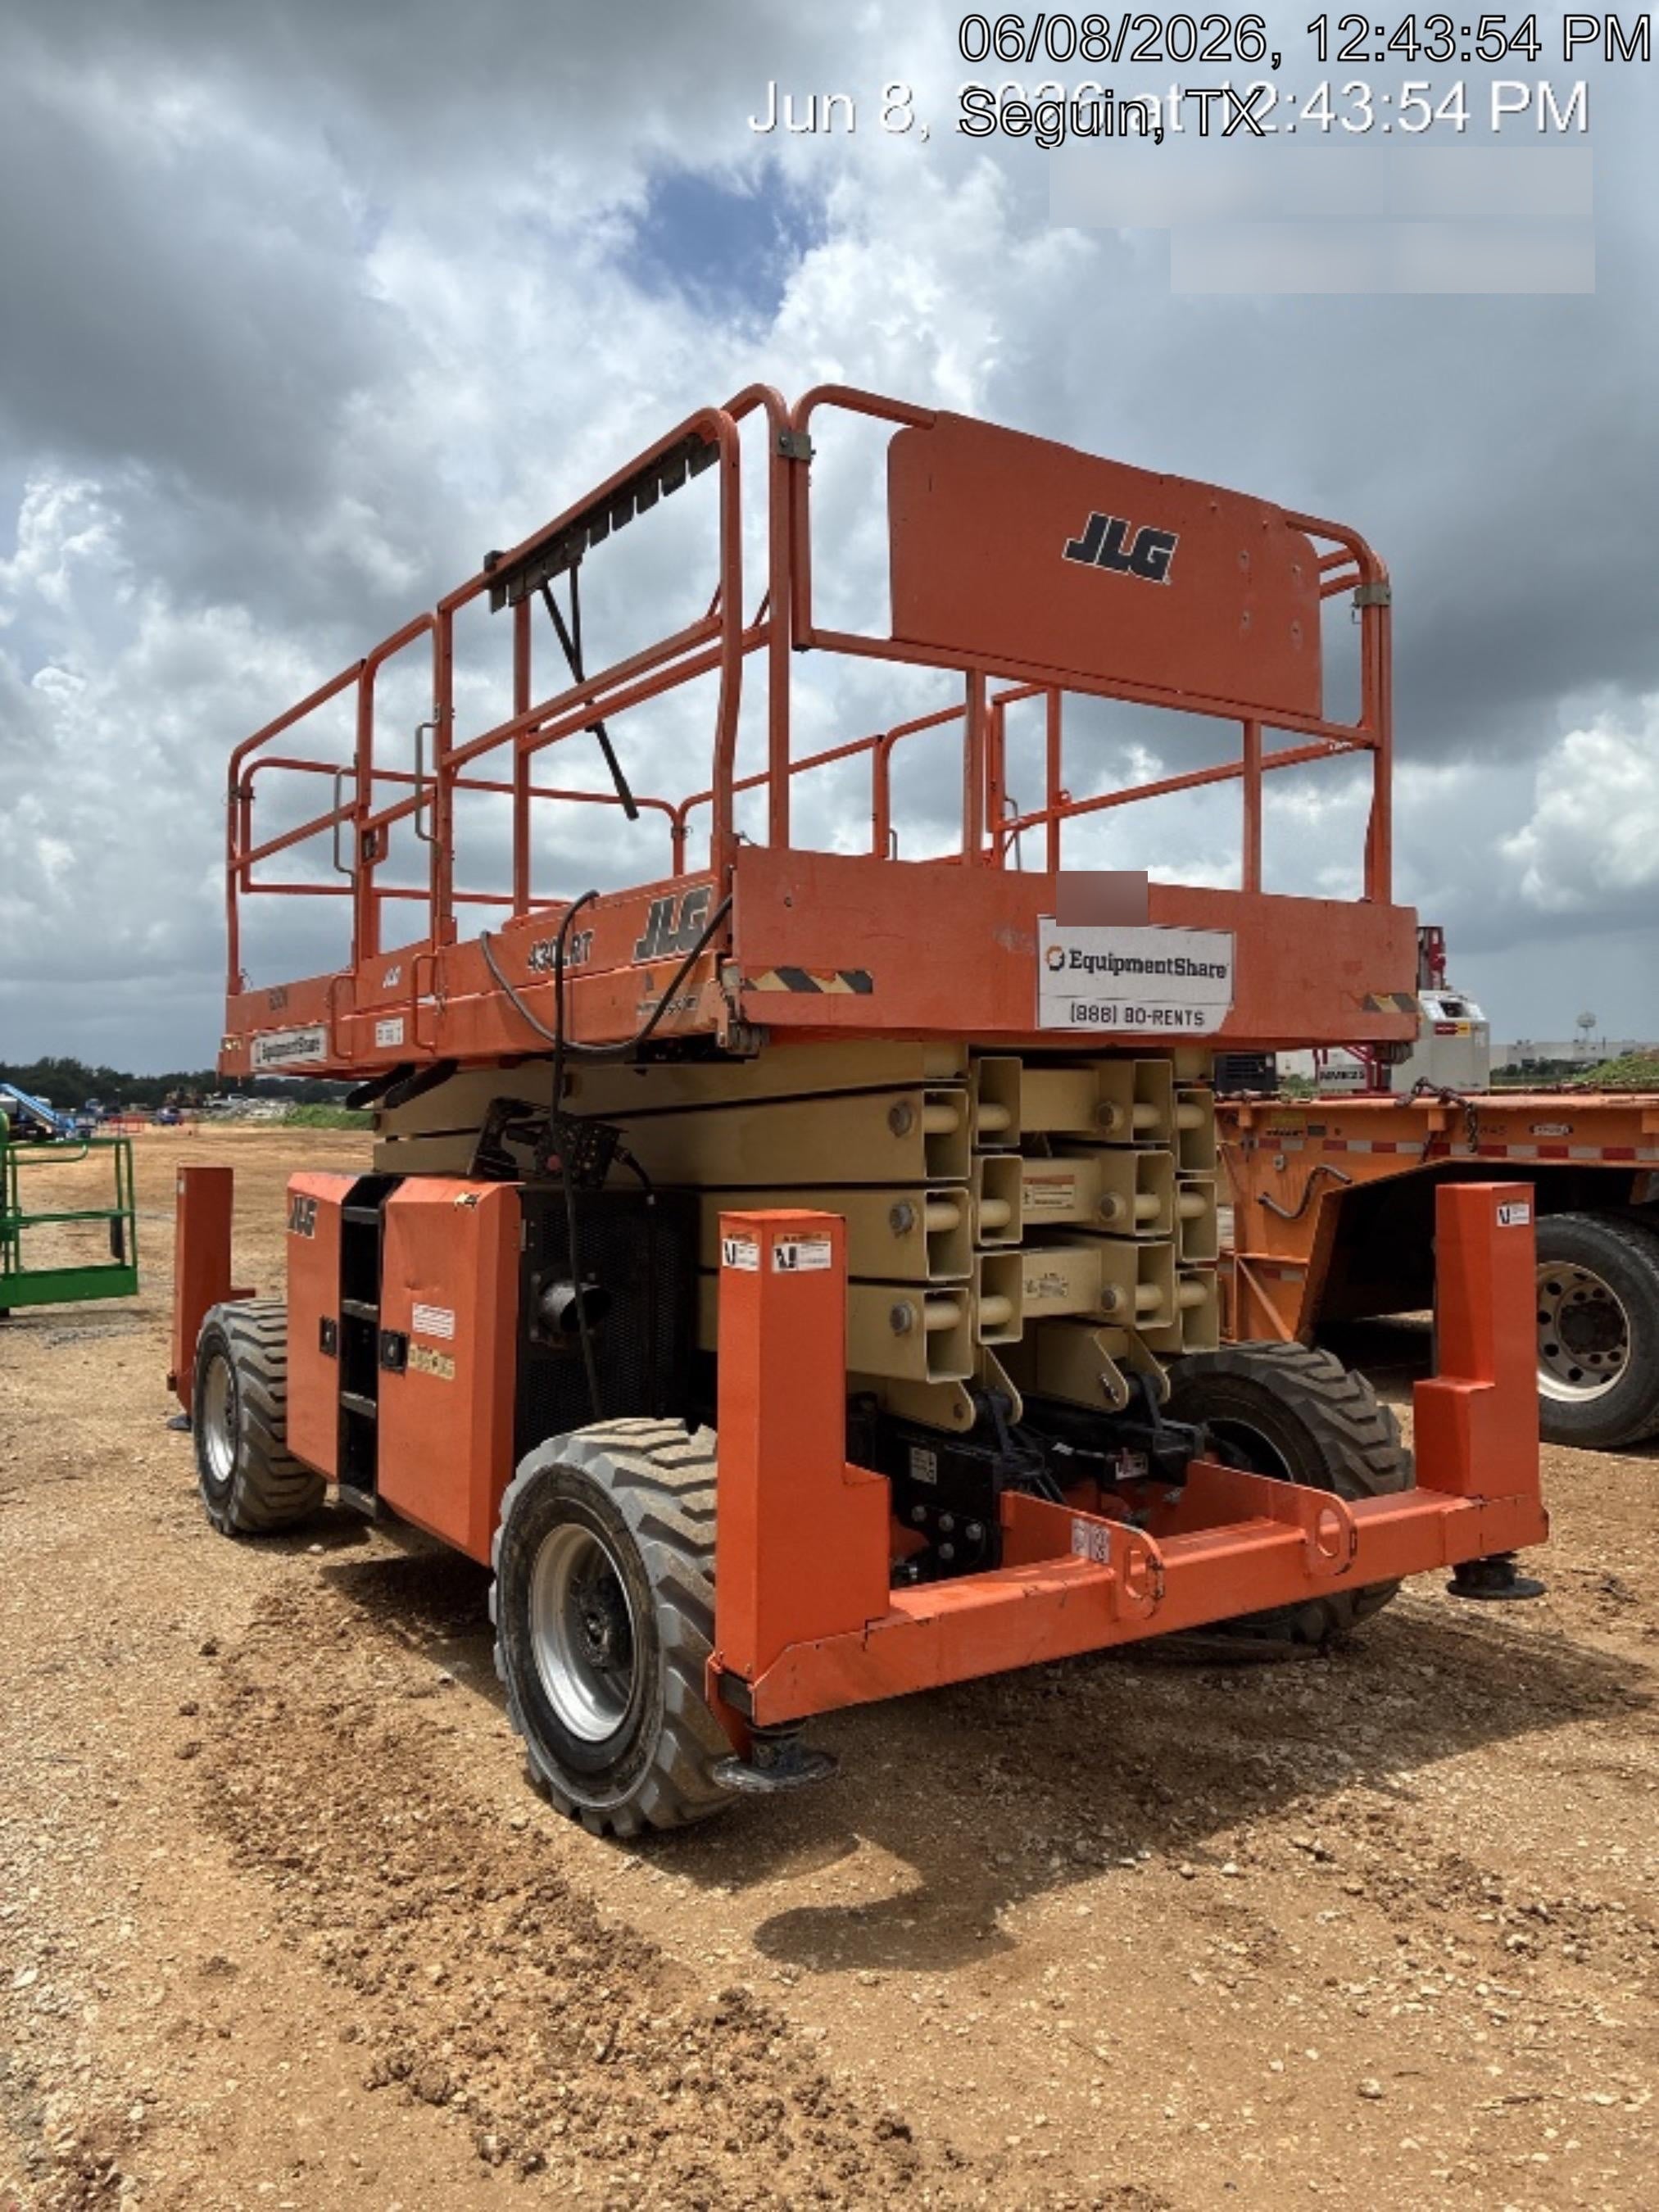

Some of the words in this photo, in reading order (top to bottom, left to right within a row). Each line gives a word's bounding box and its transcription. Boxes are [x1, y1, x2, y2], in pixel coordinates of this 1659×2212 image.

[1062, 510, 1180, 585] JLG
[632, 885, 714, 963] JLG
[1068, 948, 1227, 979] EquipmentShare
[1071, 1000, 1117, 1024] (888)
